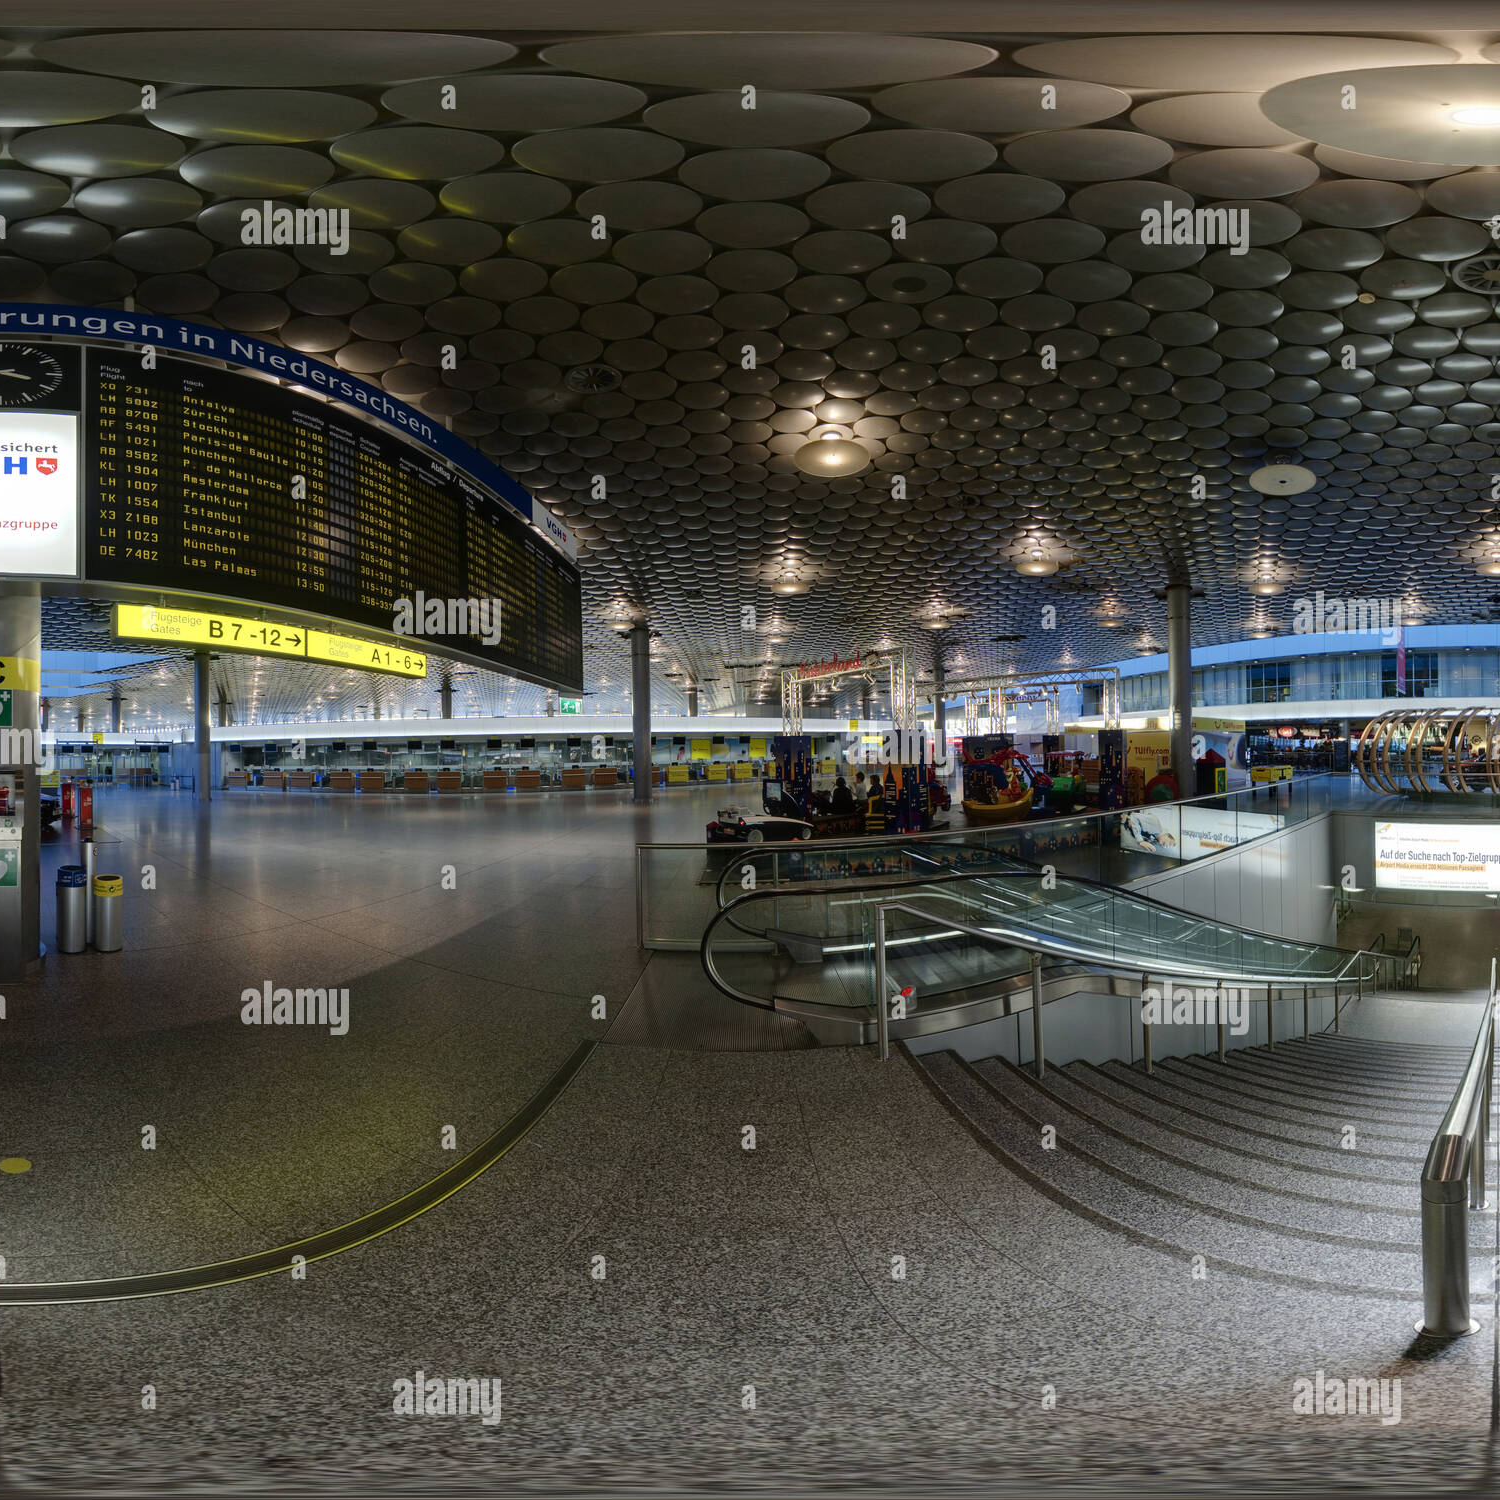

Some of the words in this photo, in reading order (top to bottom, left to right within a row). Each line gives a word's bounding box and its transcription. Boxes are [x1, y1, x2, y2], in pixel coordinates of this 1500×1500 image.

[100, 365, 120, 373] Flug
[100, 372, 125, 381] Flight
[179, 326, 214, 350] in
[230, 339, 438, 443] Niedersachsen.
[183, 380, 204, 388] nach
[100, 394, 116, 402] LH
[126, 397, 158, 408] 5082
[183, 407, 228, 423] Zürich
[295, 438, 323, 454] 10:05
[126, 385, 149, 395] 731
[295, 427, 323, 443] 10:00
[100, 407, 116, 415] AB
[126, 409, 158, 421] 8708
[183, 420, 249, 441] Stockholm
[295, 451, 323, 466] 10:15
[100, 433, 116, 441] LH
[127, 436, 157, 447] 1021
[183, 445, 235, 464] München
[100, 419, 116, 427] AF
[126, 422, 157, 434] 5491
[183, 432, 242, 453] Paris-de
[249, 448, 289, 466] Gaulle
[295, 462, 323, 479] 10:20
[100, 447, 116, 456] AB
[126, 450, 158, 462] 9582
[207, 464, 220, 474] de
[229, 469, 283, 491] Mallorca
[100, 462, 116, 471] KL
[127, 464, 158, 476] 1904
[183, 474, 249, 495] Amsterdam
[295, 502, 324, 518] 11:30
[100, 477, 116, 486] LH
[127, 480, 158, 492] 1007
[183, 489, 249, 510] Frankfurt
[295, 515, 324, 532] 11:40
[100, 493, 116, 503] TK
[127, 495, 158, 508] 1554
[183, 505, 241, 524] Istanbul
[296, 531, 324, 547] 12:00
[100, 510, 116, 520] X3
[126, 513, 158, 525] 2188
[183, 522, 250, 542] Lanzarote
[296, 546, 324, 561] 12:30
[361, 566, 393, 584] 301-310
[546, 518, 562, 538] VGH
[100, 527, 116, 537] LH
[127, 530, 158, 542] 1023
[183, 538, 236, 555] München
[296, 561, 325, 577] 12:55
[100, 546, 116, 556] DE
[126, 548, 158, 561] 7482
[183, 555, 207, 568] Las
[215, 561, 257, 577] Palmas
[297, 577, 325, 593] 13:50
[150, 611, 203, 626] Flugsteige
[209, 620, 224, 638] B
[232, 623, 243, 641] 7
[150, 623, 181, 635] Gates
[328, 647, 350, 658] Gates
[328, 637, 363, 652] Flugsteige
[371, 649, 381, 664] A
[384, 651, 390, 665] 1
[404, 655, 411, 669] 6
[1134, 747, 1169, 755] TUIfly.com
[1380, 850, 1393, 859] Auf
[1395, 851, 1406, 859] der
[1408, 851, 1431, 860] Suche
[1433, 852, 1451, 861] nach
